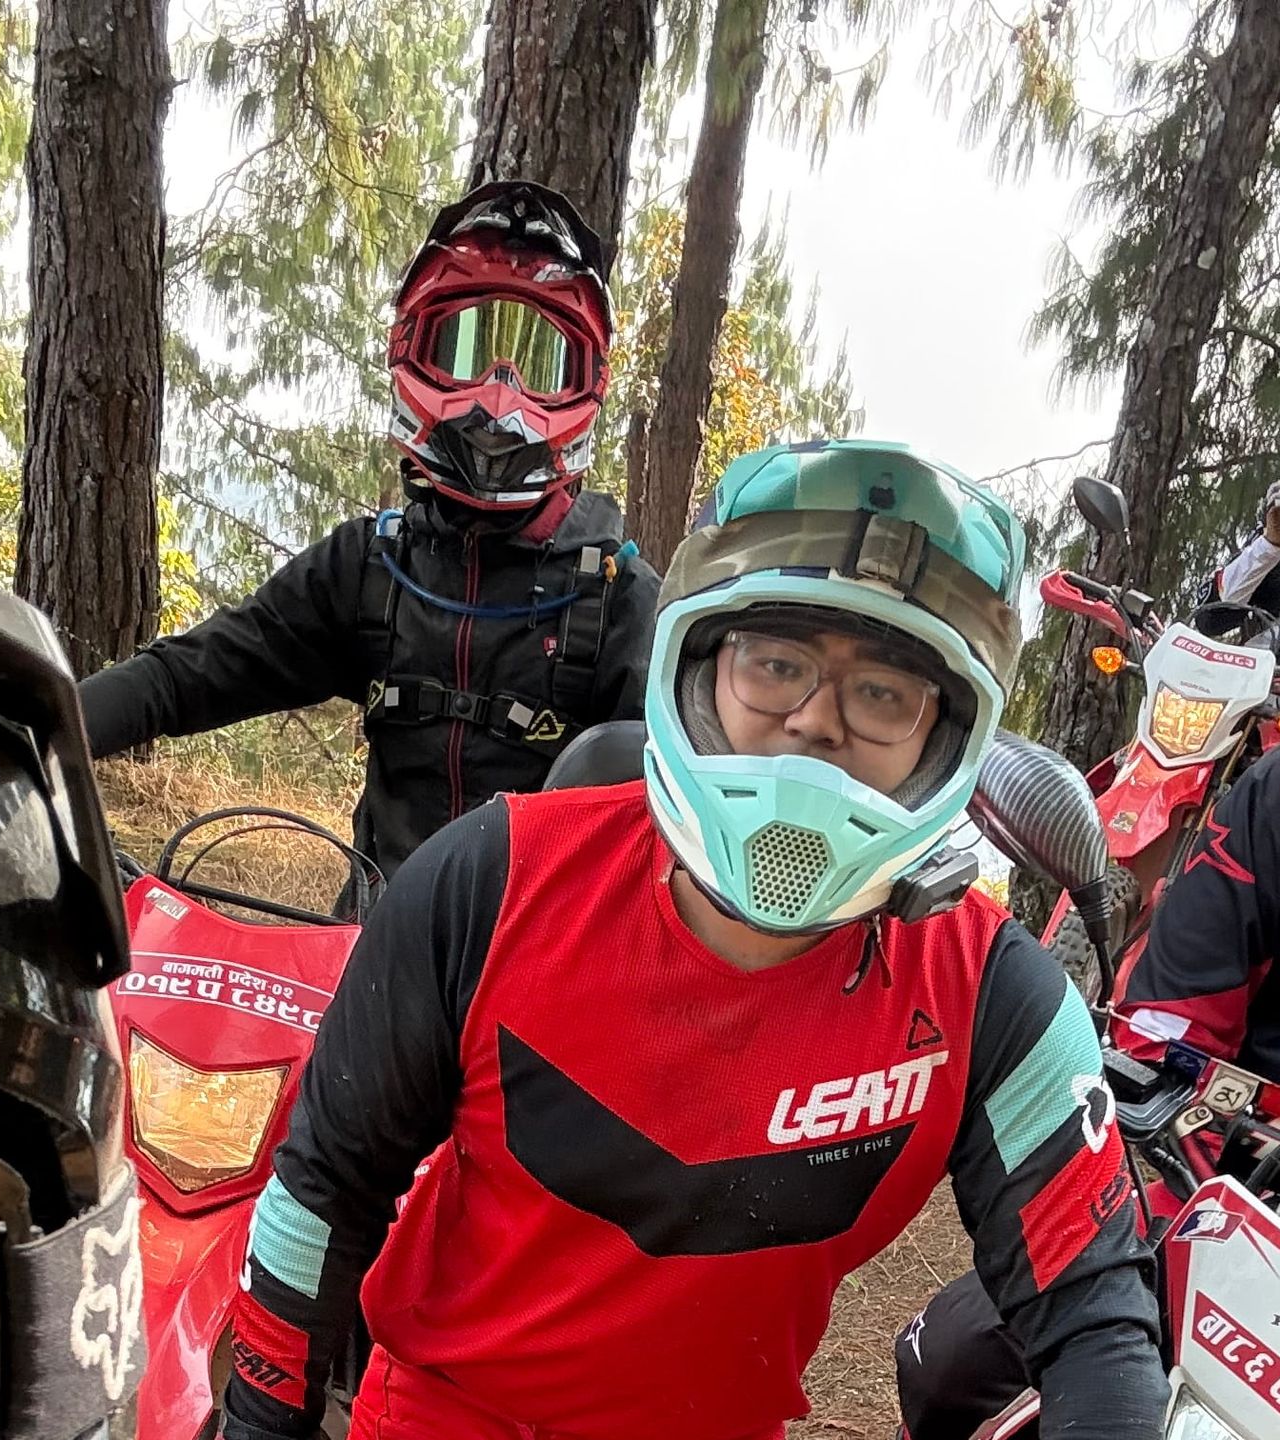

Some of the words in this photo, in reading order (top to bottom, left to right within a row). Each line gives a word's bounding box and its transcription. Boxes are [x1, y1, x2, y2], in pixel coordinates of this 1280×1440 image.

[162, 962, 224, 980] बागमती
[767, 1050, 950, 1144] LEATT
[807, 1148, 851, 1166] THREE
[864, 1136, 893, 1153] FIVE
